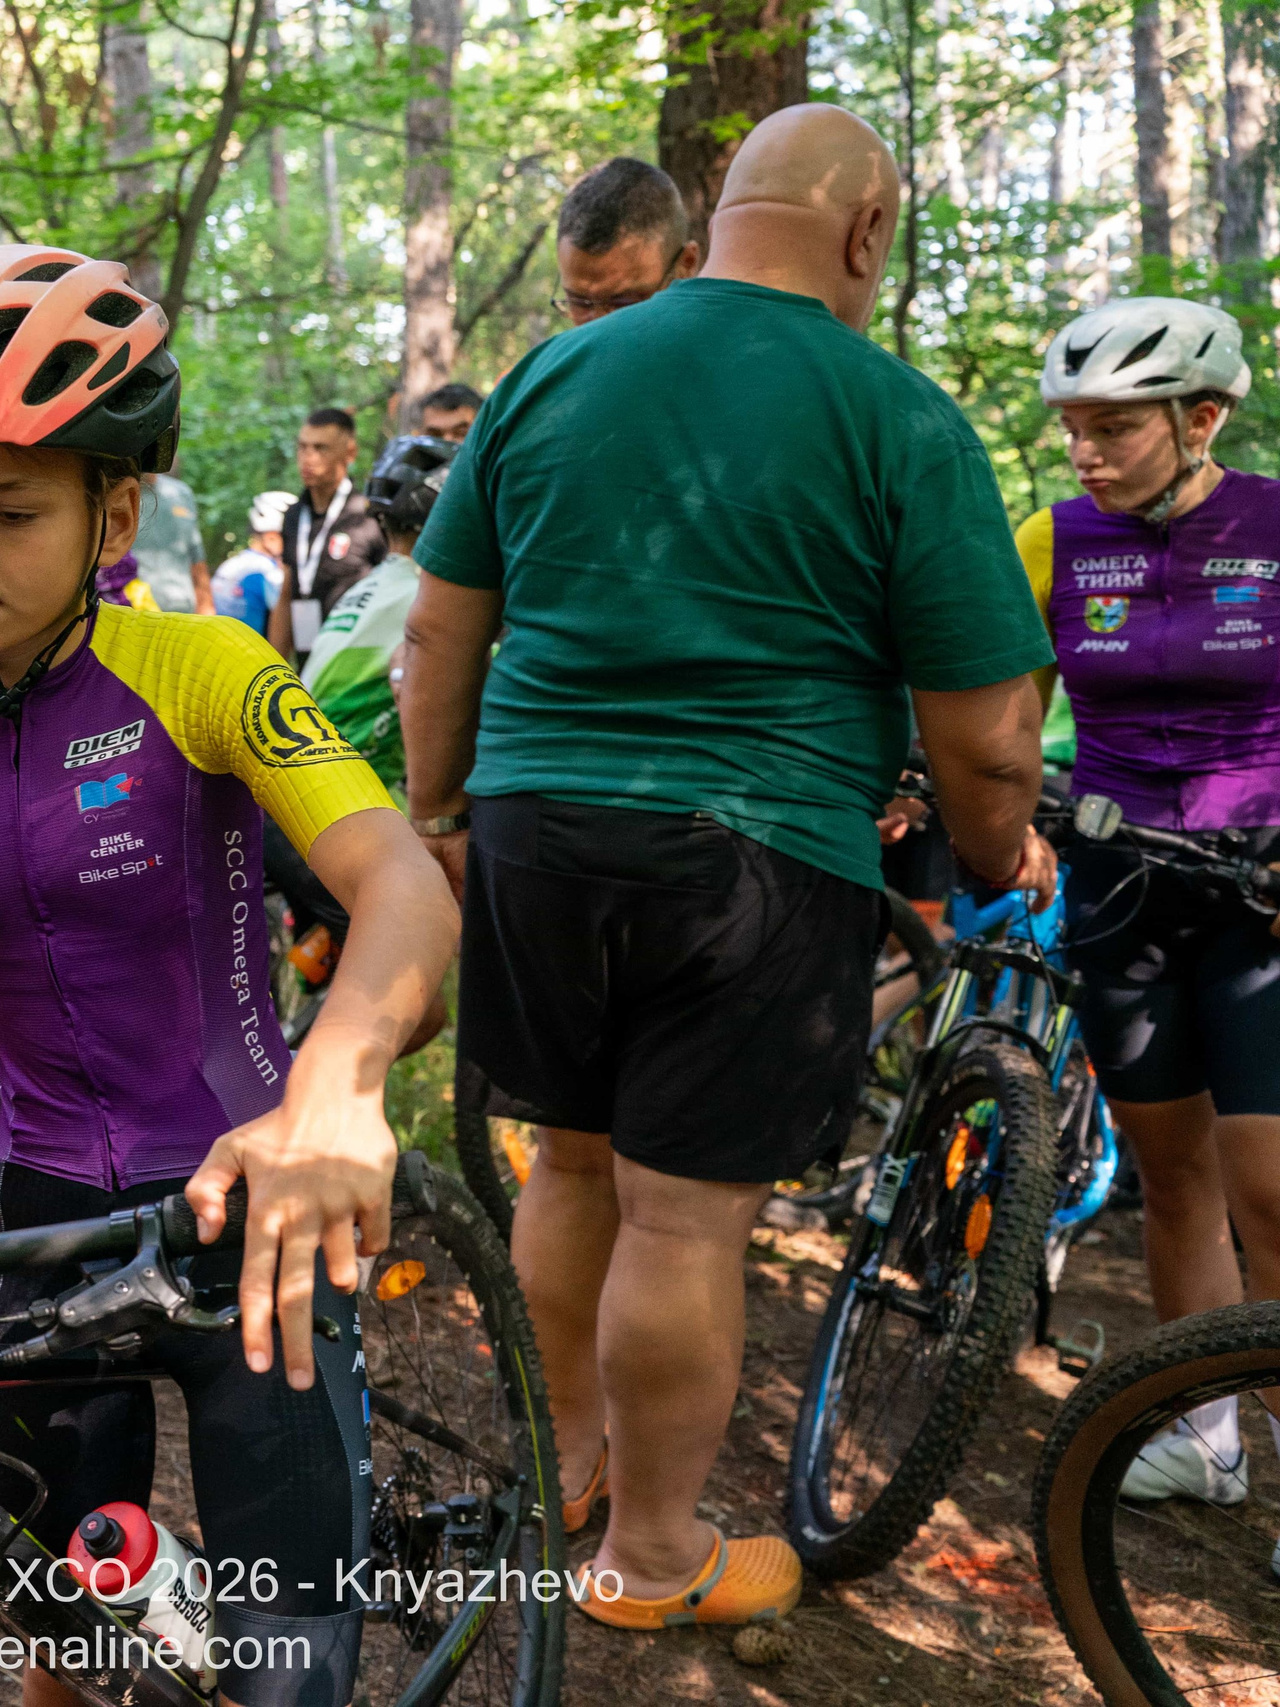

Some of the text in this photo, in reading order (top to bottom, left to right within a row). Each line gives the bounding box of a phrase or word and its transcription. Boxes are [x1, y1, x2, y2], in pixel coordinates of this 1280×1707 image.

[1072, 554, 1149, 572] ОМЕГА
[1075, 571, 1145, 589] ТИЙМ
[72, 722, 142, 757] DIEM
[72, 743, 136, 768] SPORT
[90, 838, 144, 859] CENTER
[99, 832, 133, 848] BIKE
[224, 830, 279, 1087] SCC Omega Team
